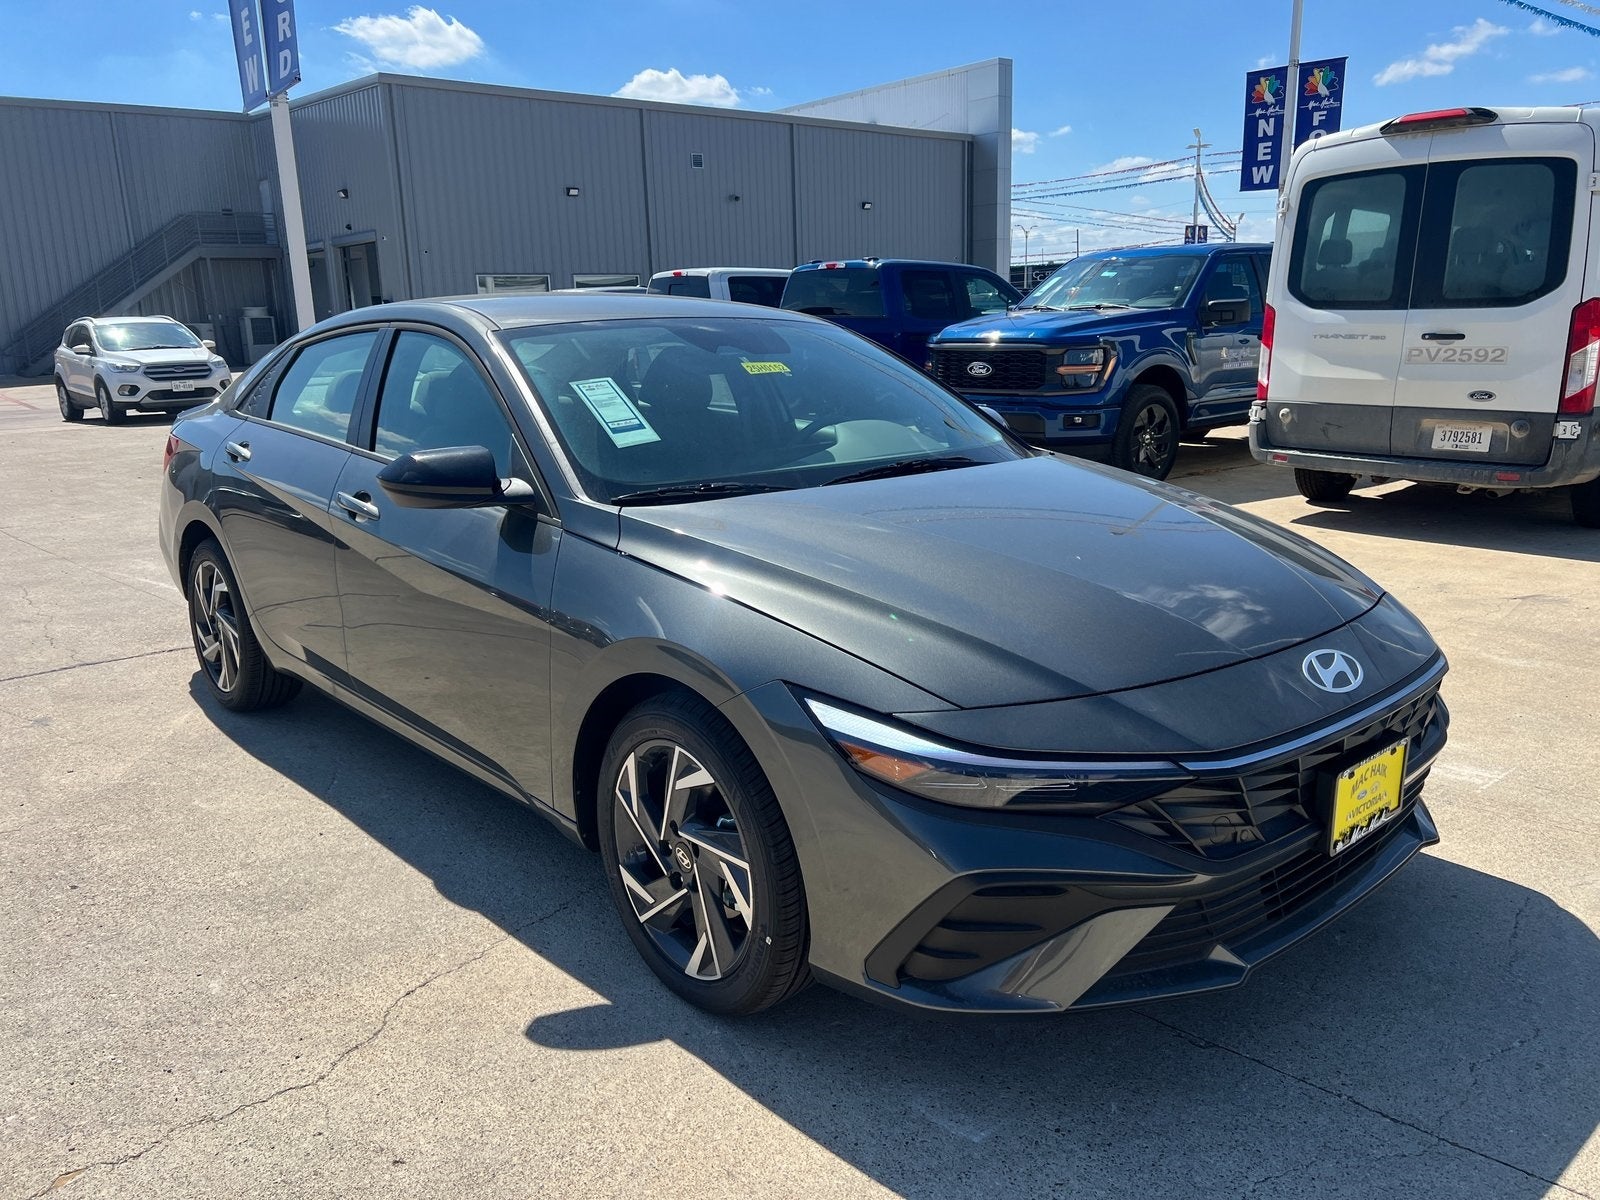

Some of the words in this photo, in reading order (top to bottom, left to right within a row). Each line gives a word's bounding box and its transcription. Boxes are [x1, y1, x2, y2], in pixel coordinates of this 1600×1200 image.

[276, 0, 292, 80] RD
[1252, 117, 1275, 185] NEW
[1312, 333, 1369, 341] TRANSIT
[1407, 346, 1507, 364] PV2592
[969, 362, 991, 376] Ford
[1440, 430, 1483, 444] 3792581
